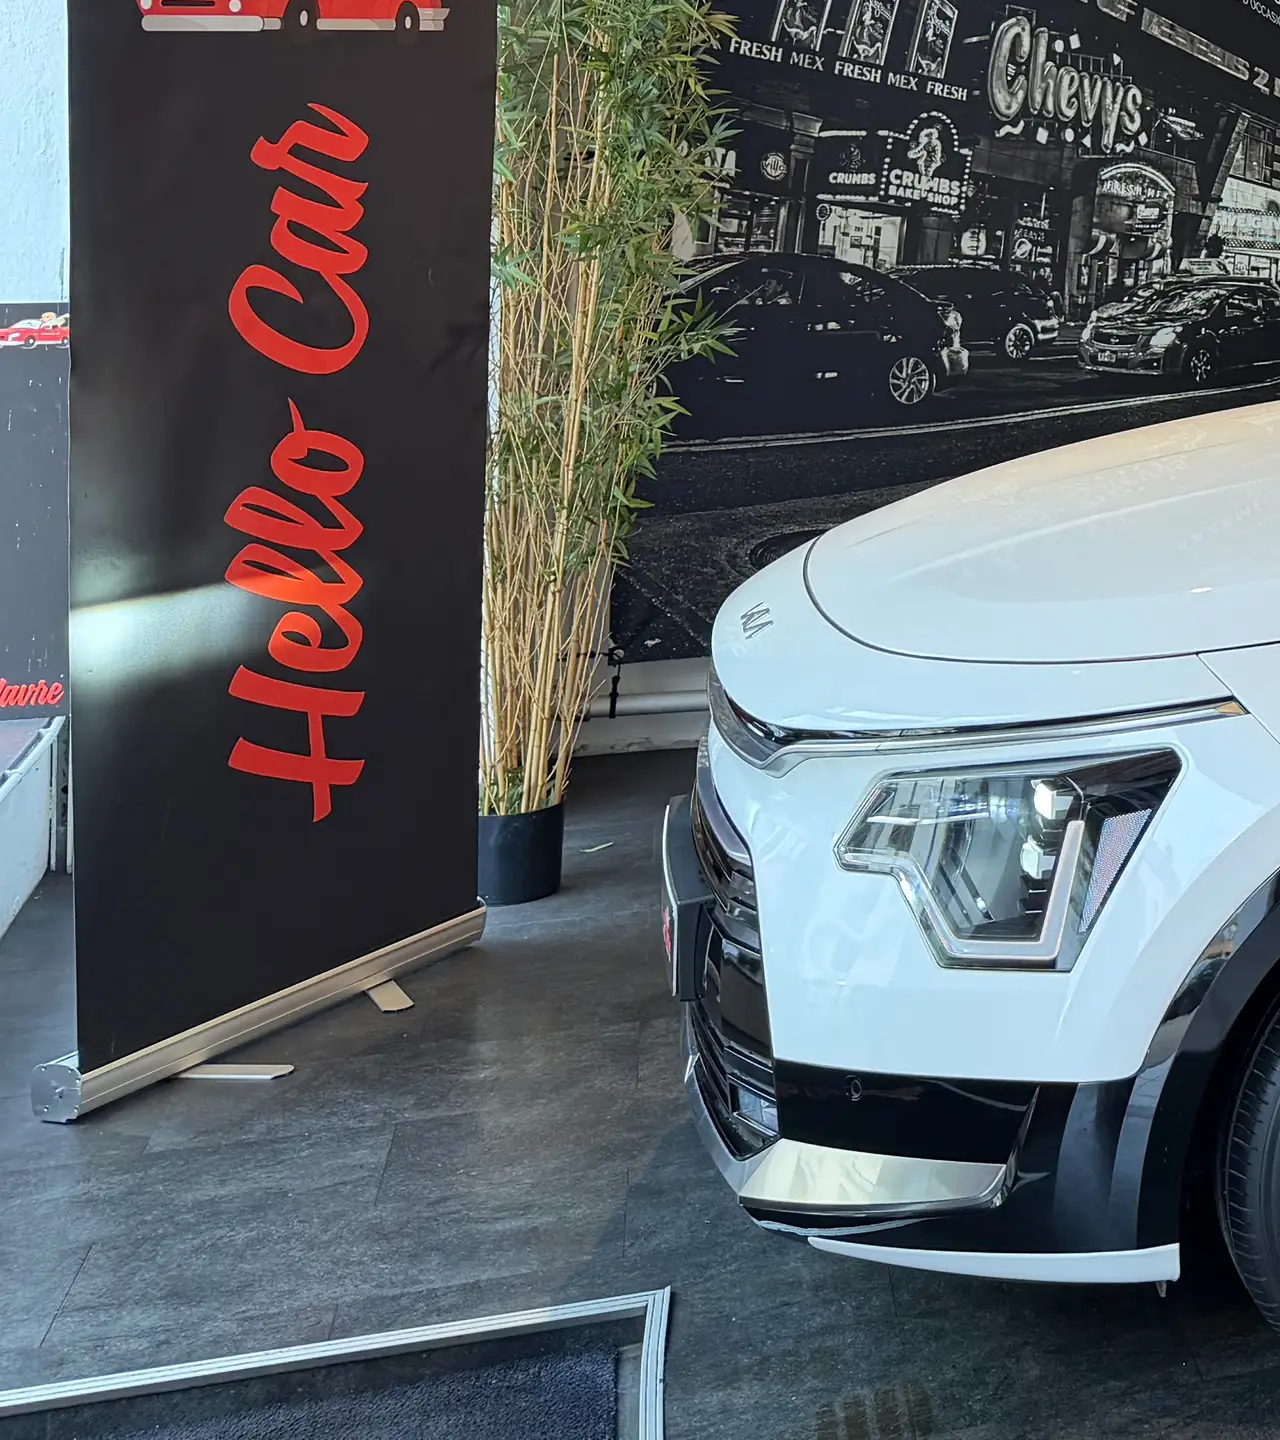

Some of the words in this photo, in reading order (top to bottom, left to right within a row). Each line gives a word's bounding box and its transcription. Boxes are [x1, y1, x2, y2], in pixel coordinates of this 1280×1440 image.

[729, 38, 784, 62] FRESH
[790, 51, 824, 72] MEX
[834, 61, 882, 84] FRESH
[887, 73, 919, 91] MEX
[926, 81, 968, 102] FRESH
[988, 15, 1142, 154] Chevys
[829, 172, 877, 185] CRUMBS
[889, 168, 961, 196] CRUMBS
[228, 102, 370, 374] Car
[224, 398, 365, 821] Hello
